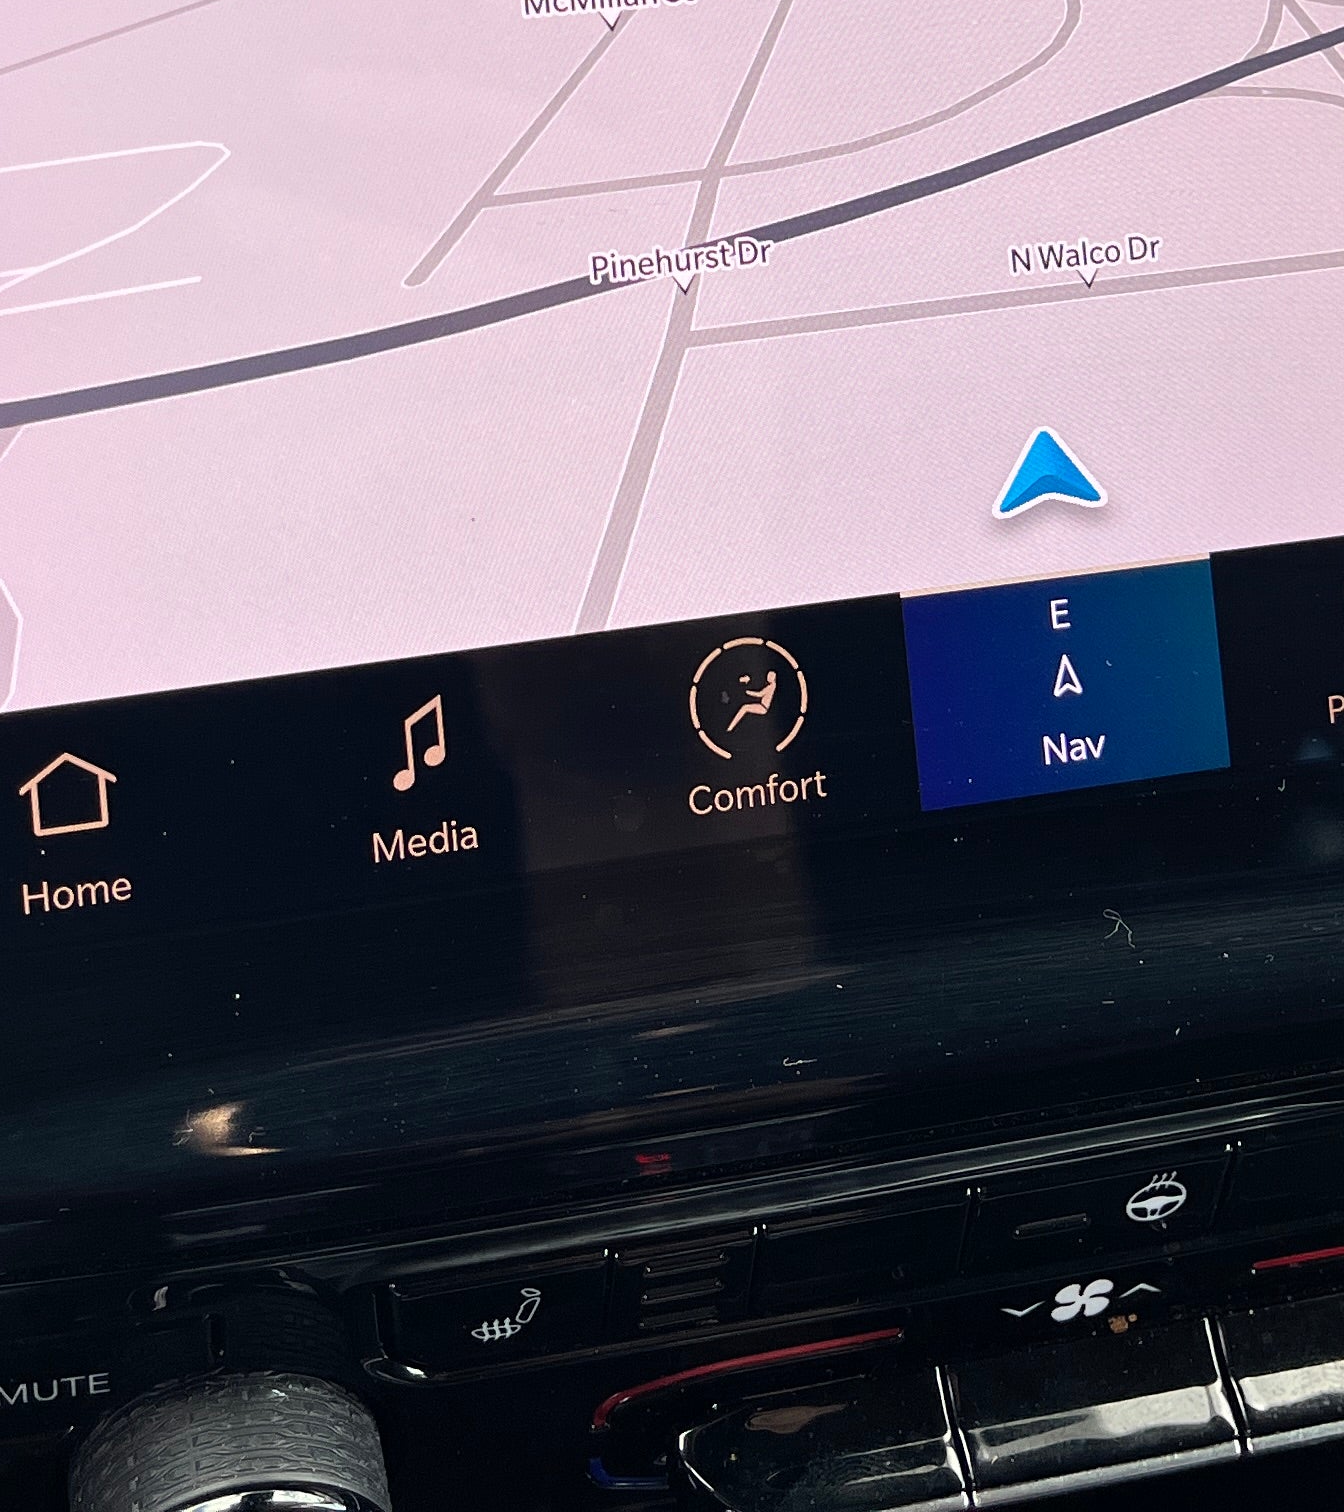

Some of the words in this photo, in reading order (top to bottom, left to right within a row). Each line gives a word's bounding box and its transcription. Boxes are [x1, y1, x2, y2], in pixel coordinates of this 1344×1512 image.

[591, 244, 730, 281] Pinehurst
[736, 240, 771, 266] Dr
[1011, 247, 1032, 273] N
[1038, 242, 1121, 268] Walco
[1127, 235, 1160, 261] Dr
[1049, 599, 1071, 630] E
[1043, 733, 1106, 765] Nav
[689, 770, 828, 815] Comfort
[372, 820, 480, 863] Media
[21, 876, 133, 915] Home
